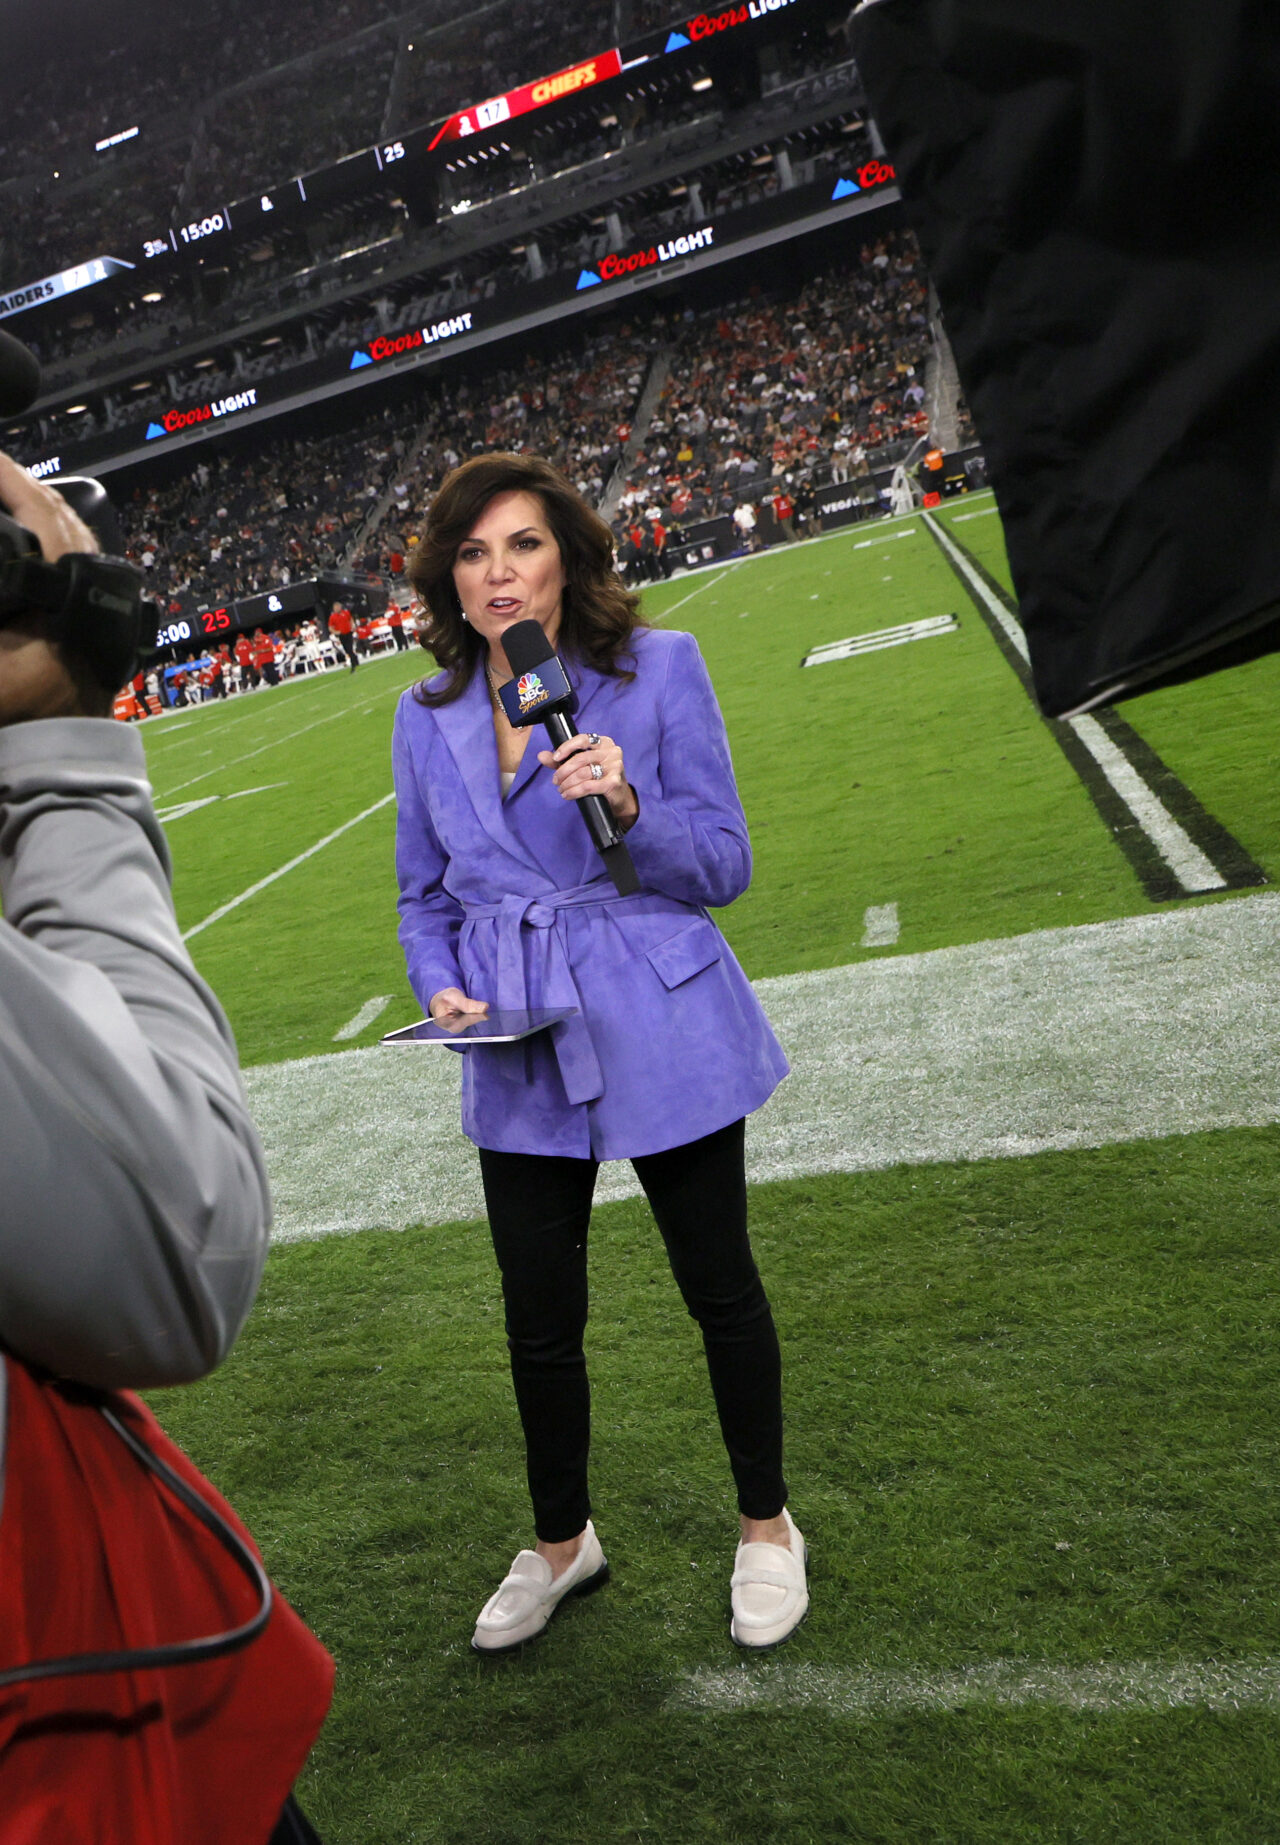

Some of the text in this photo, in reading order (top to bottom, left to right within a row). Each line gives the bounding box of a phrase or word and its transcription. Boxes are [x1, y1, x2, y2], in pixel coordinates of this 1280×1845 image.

[687, 4, 749, 42] Coors
[531, 62, 597, 103] CHIEFS
[180, 214, 224, 243] 15:00
[383, 141, 406, 163] 25
[597, 226, 714, 280] Coors LIGHT
[368, 312, 472, 361] Coors LIGHT
[161, 388, 257, 432] Coors LIGHT
[25, 456, 61, 478] IGHT
[201, 608, 231, 633] 25
[268, 595, 282, 612] &
[519, 683, 546, 703] NBC
[519, 689, 550, 714] Sports
